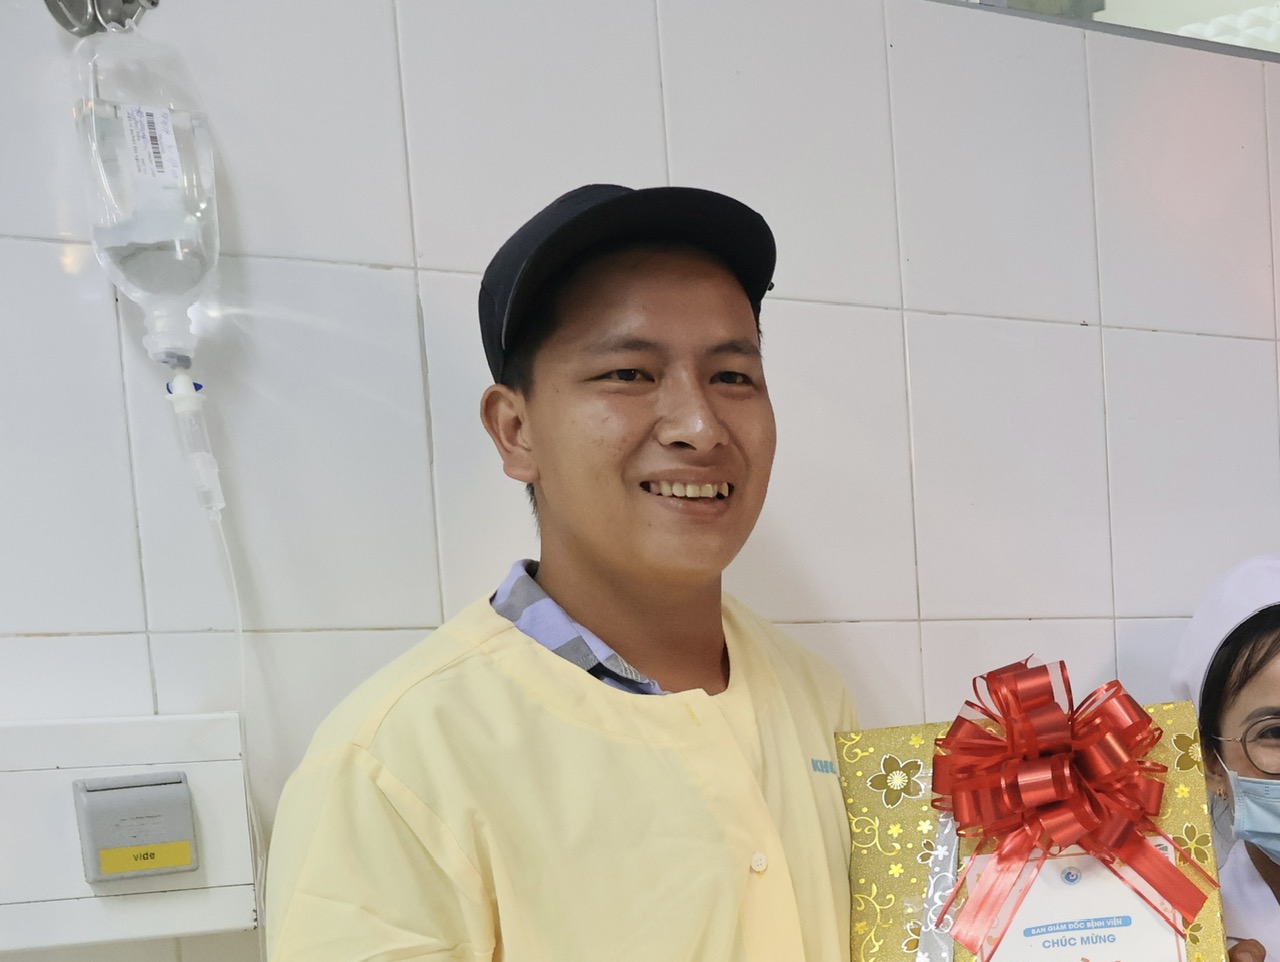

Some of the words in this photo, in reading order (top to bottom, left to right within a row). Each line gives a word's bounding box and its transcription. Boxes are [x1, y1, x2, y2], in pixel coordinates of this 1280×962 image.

[1068, 921, 1085, 930] ĐỐC
[1086, 919, 1105, 929] BỆNH
[1106, 917, 1122, 926] VIỆN
[1042, 936, 1077, 949] CHÚC
[1080, 933, 1116, 946] MỪNG
